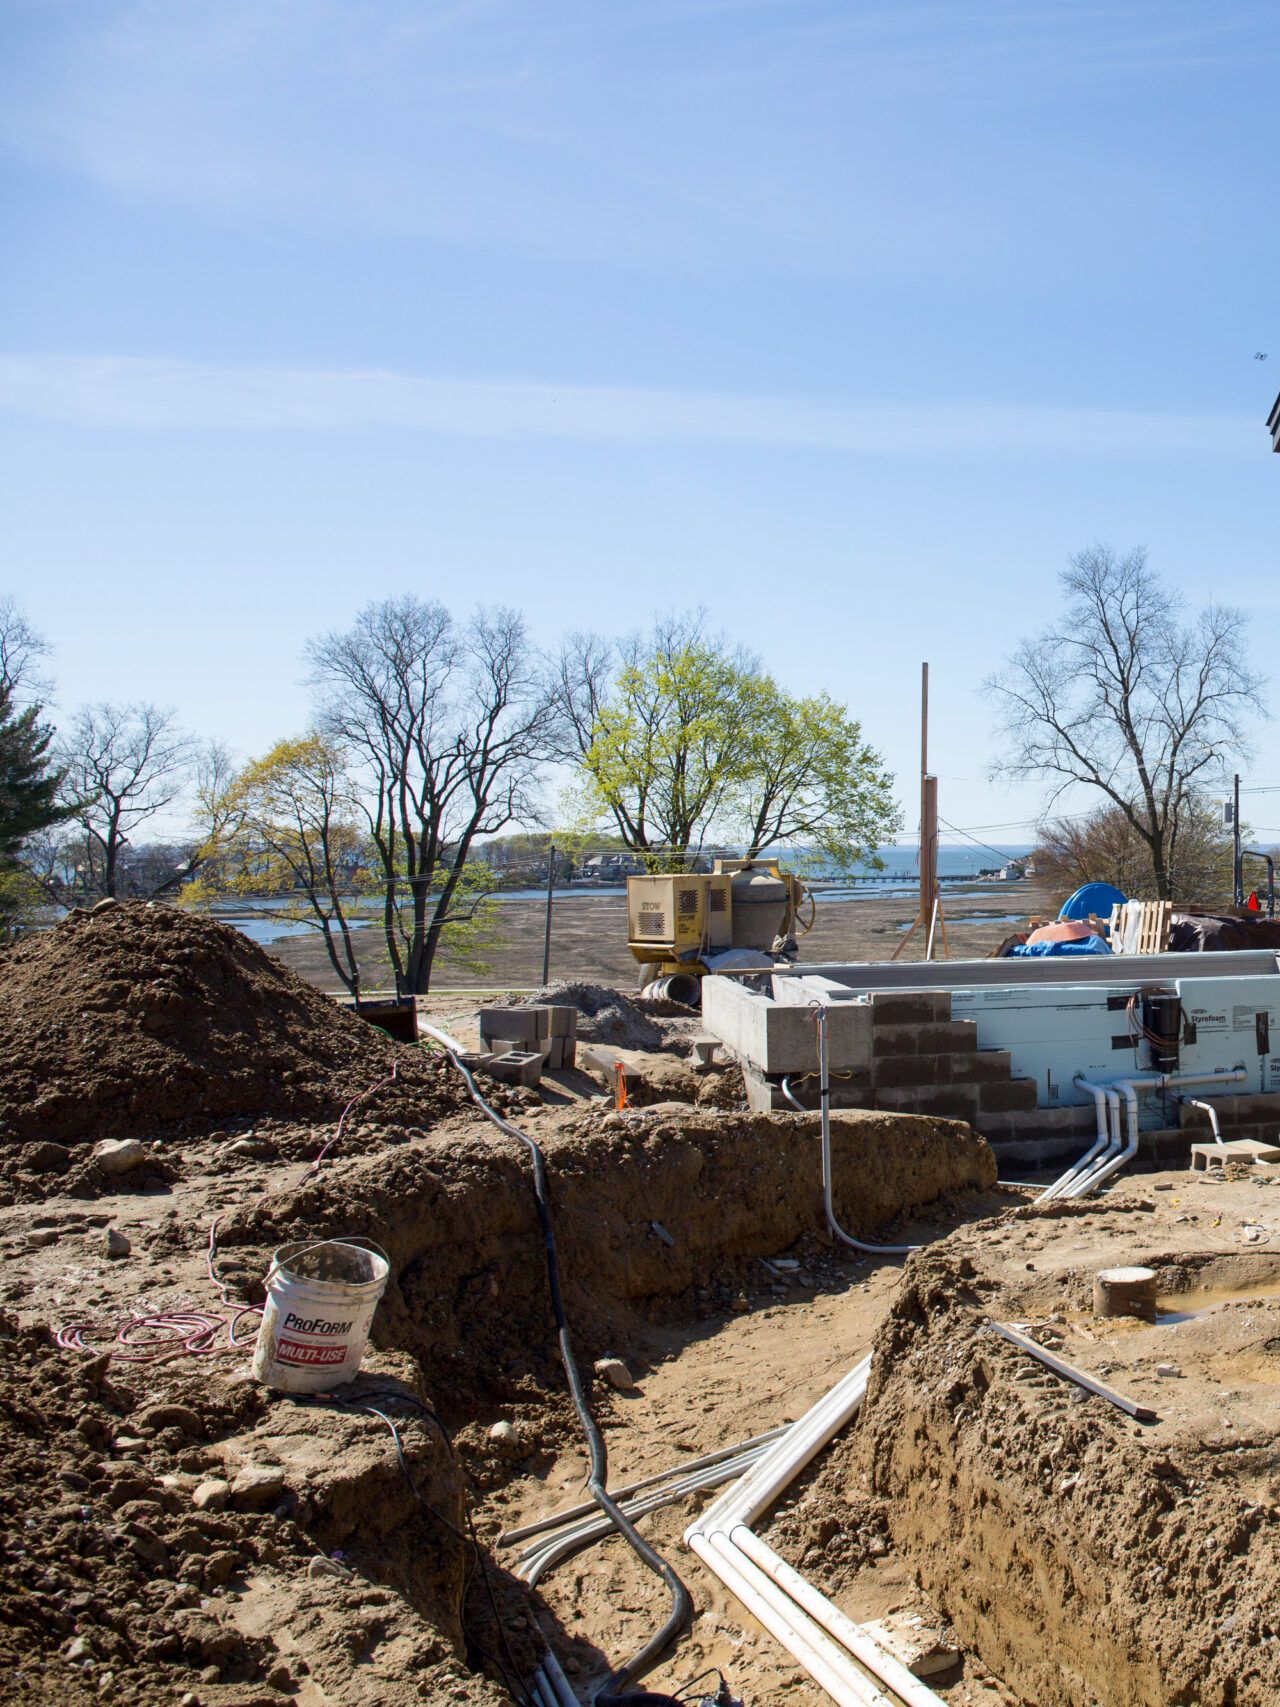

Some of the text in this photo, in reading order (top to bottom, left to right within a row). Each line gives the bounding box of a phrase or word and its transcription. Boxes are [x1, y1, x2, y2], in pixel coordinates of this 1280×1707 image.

[642, 902, 661, 910] STOW
[1191, 1014, 1226, 1023] Styrofoam
[279, 1343, 345, 1360] MULTI-USE
